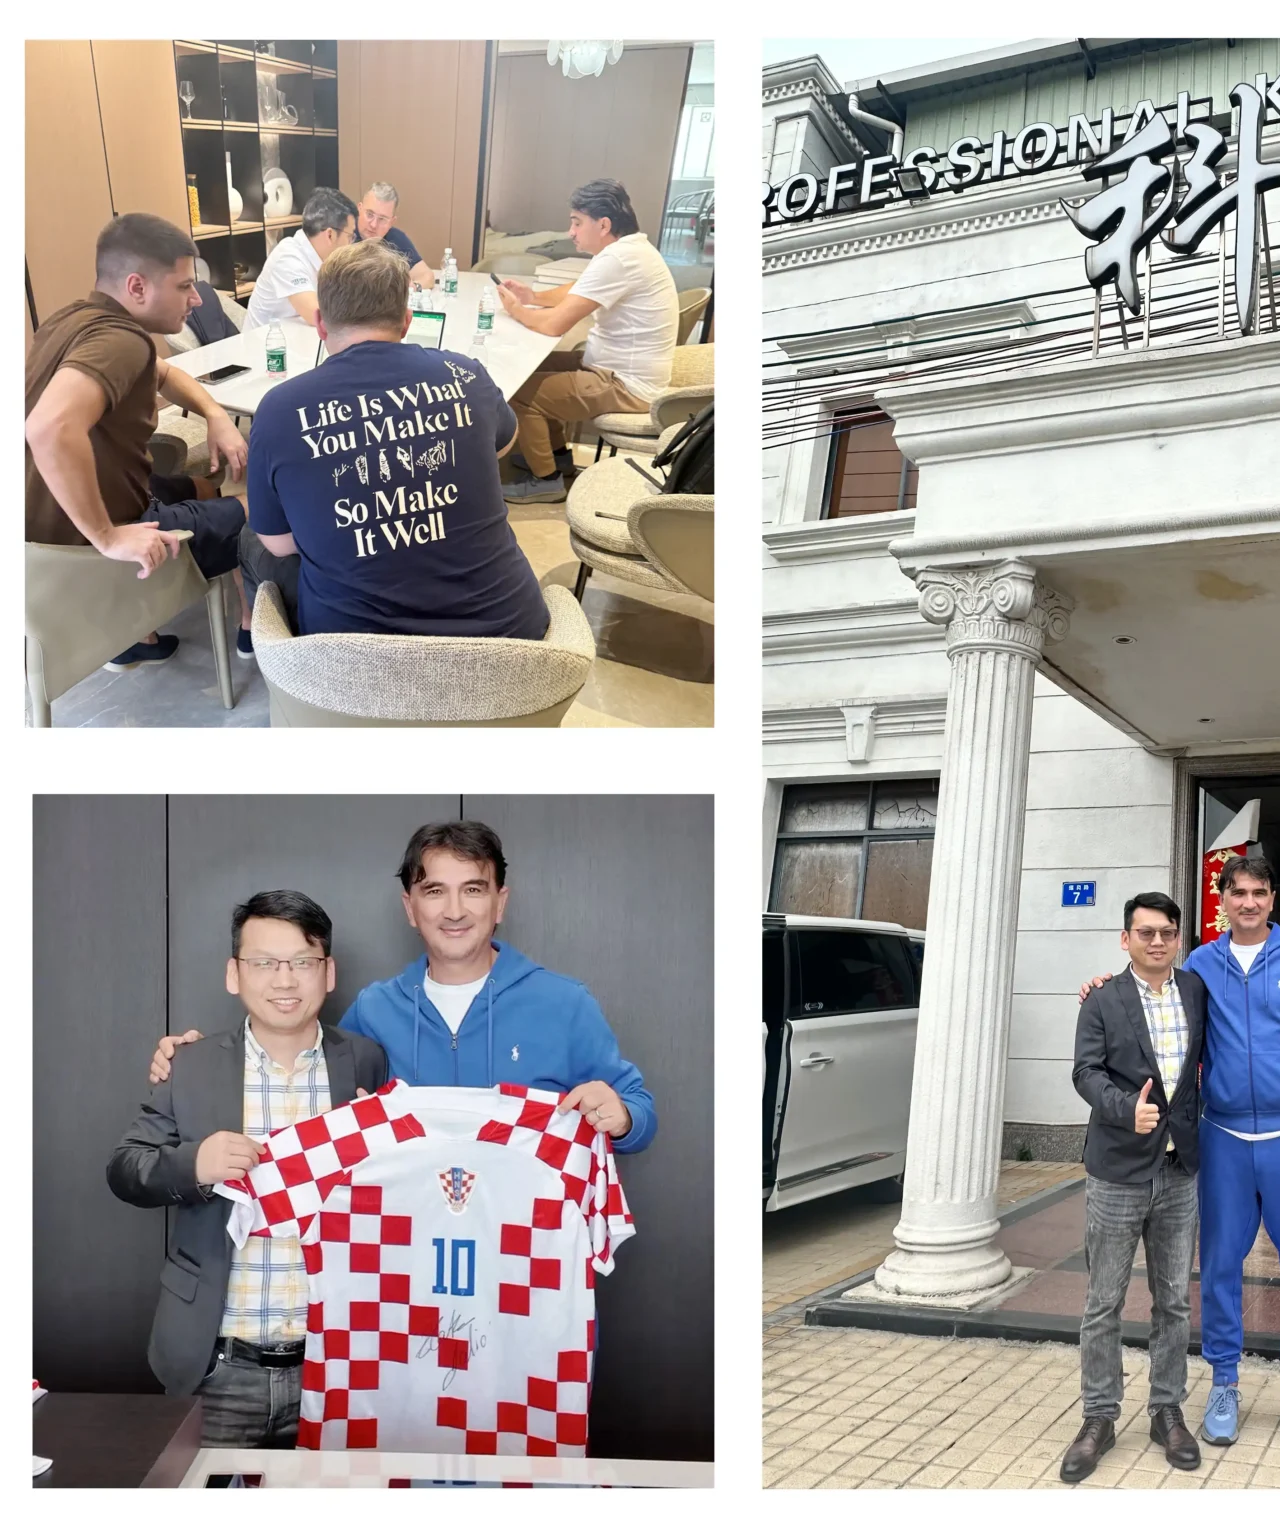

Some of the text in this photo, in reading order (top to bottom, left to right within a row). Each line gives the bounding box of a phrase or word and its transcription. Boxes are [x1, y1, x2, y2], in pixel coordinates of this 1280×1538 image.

[297, 380, 466, 432] Life Is What
[302, 402, 473, 460] You Make It
[334, 481, 458, 528] So Make
[354, 511, 446, 558] It Well
[1073, 891, 1081, 904] 7
[432, 1238, 476, 1296] 10
